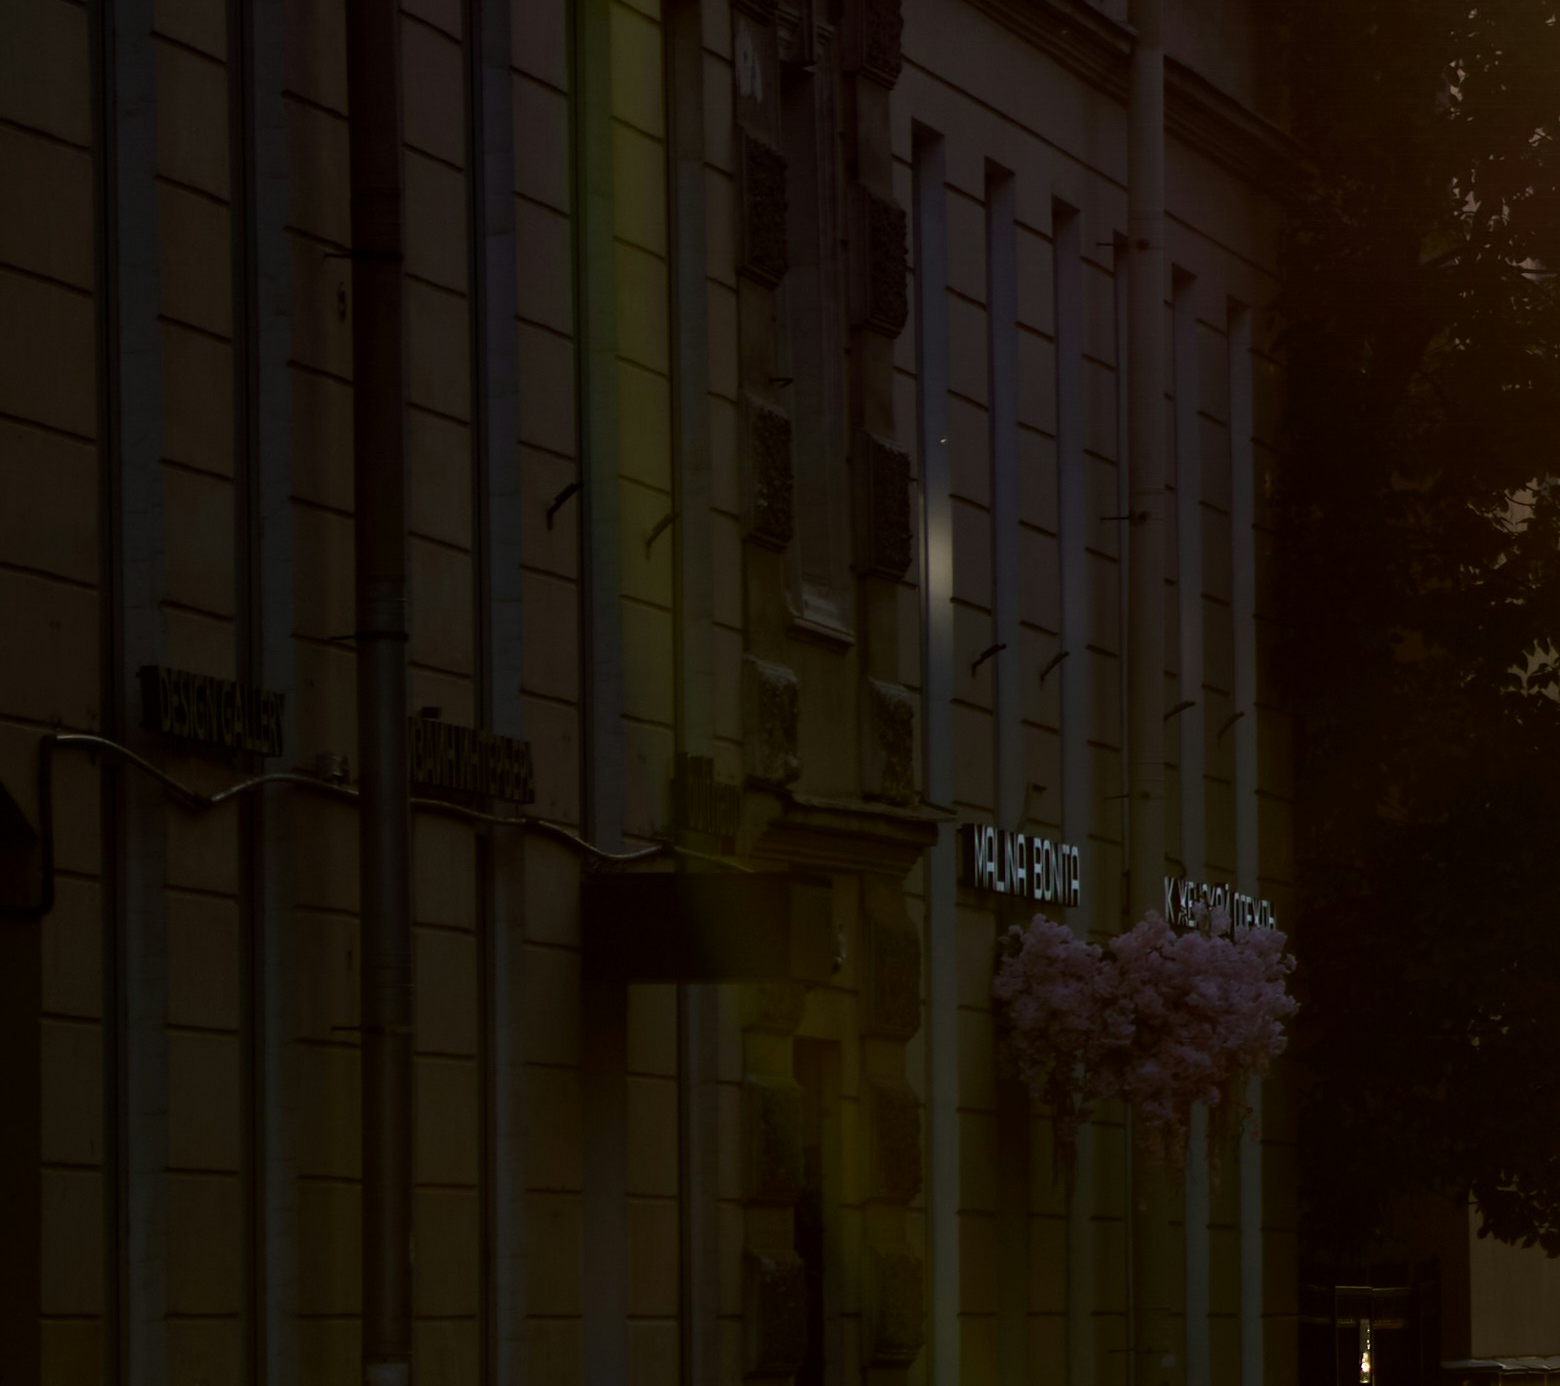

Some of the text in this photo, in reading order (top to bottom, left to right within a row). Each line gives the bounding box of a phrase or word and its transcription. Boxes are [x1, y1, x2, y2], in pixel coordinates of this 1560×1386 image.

[159, 666, 285, 756] DESIGN GALLERY
[407, 716, 456, 789] ИЗАЙН
[974, 823, 1027, 897] MALINA
[1033, 836, 1080, 906] BONITA
